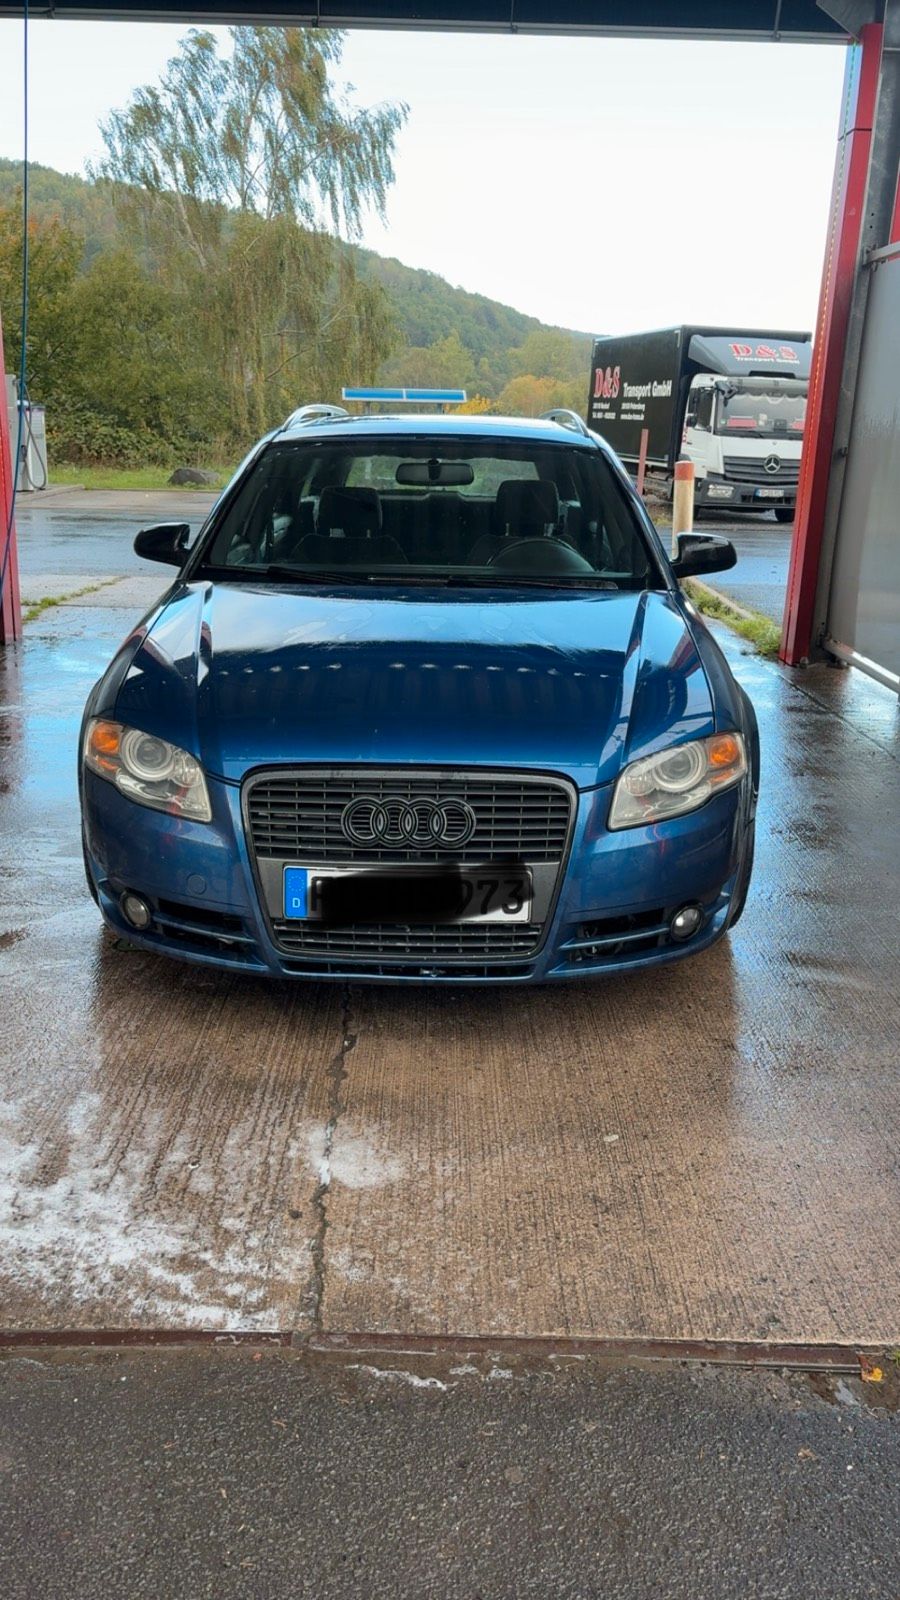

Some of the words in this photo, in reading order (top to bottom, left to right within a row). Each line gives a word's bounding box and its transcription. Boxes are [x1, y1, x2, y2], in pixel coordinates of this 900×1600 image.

[623, 381, 651, 400] Transport
[652, 380, 673, 397] GmbH
[292, 897, 300, 908] D
